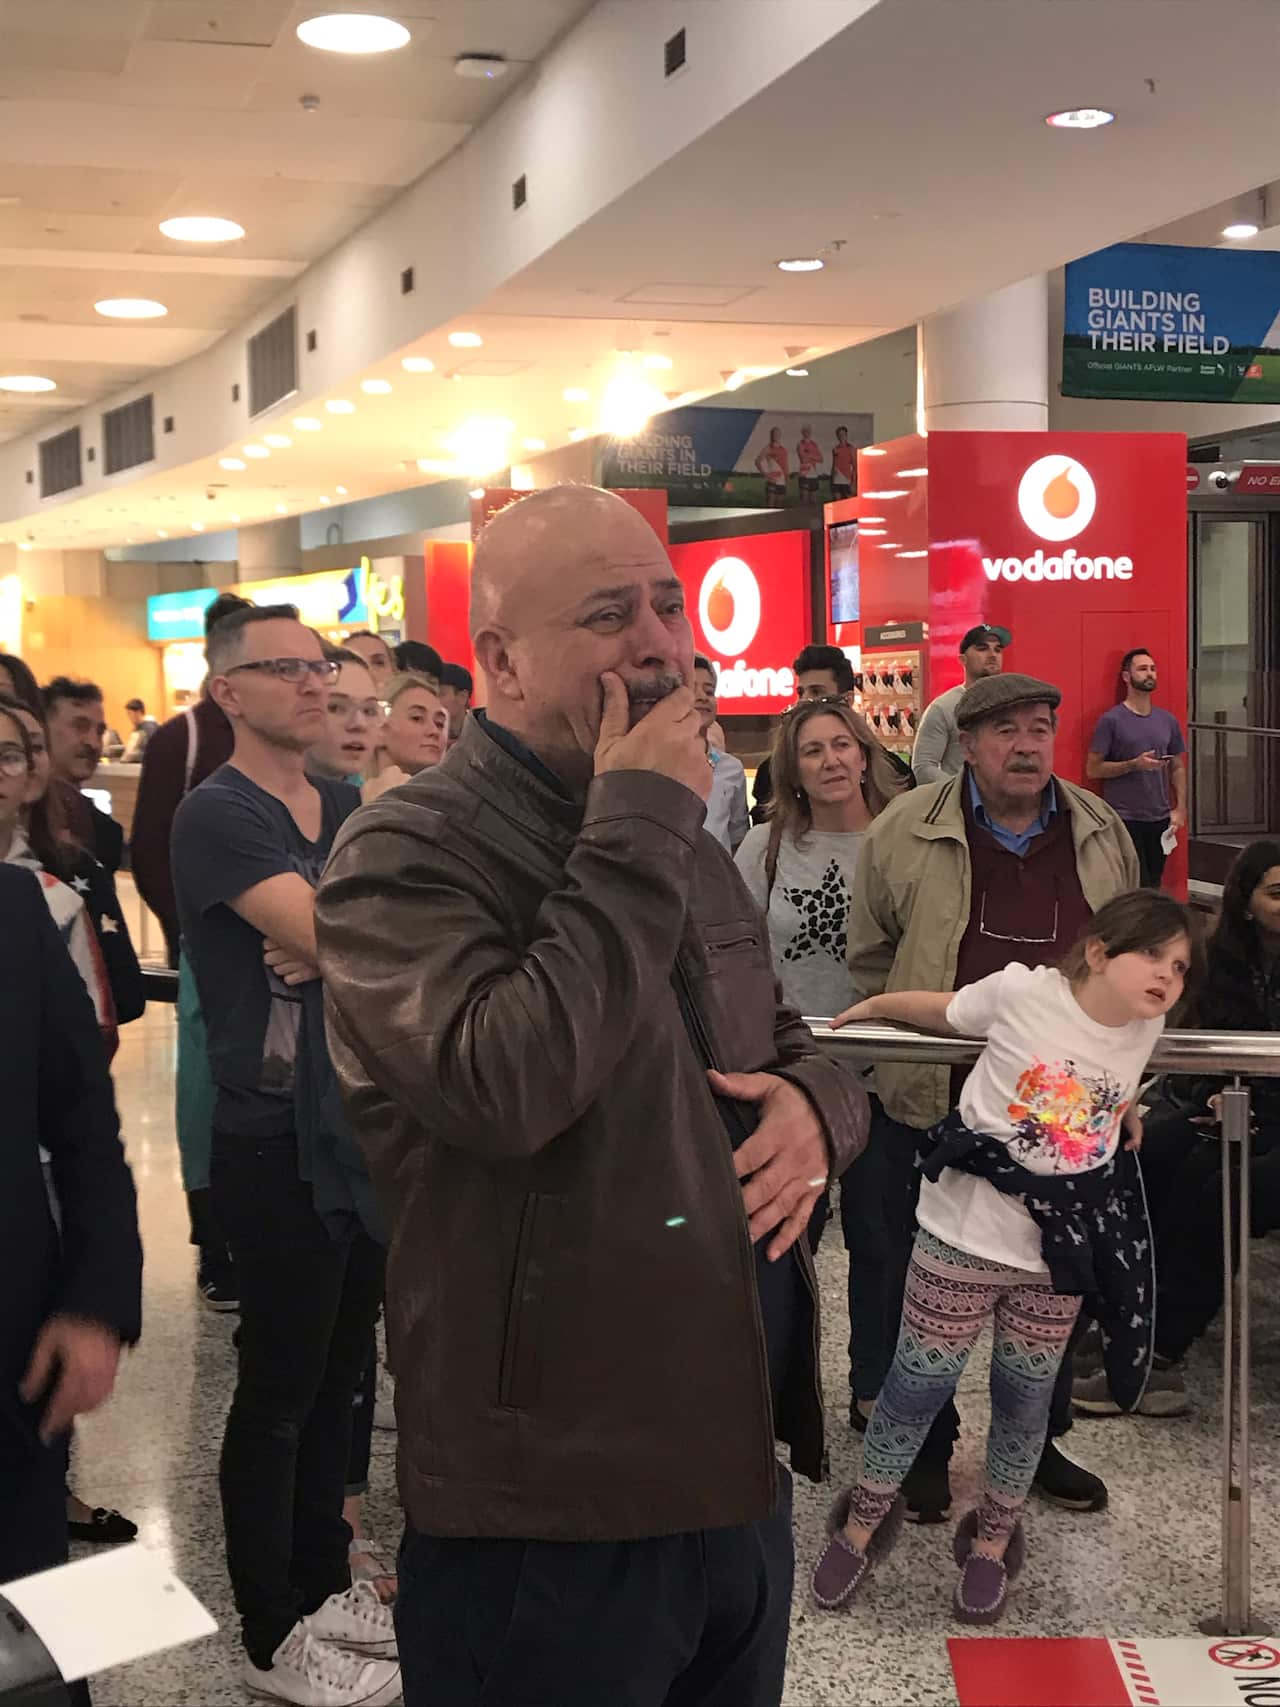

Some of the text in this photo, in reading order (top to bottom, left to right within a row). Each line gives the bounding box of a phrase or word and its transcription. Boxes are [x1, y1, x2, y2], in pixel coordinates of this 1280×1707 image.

[1088, 287, 1200, 312] BUILDING
[1088, 309, 1205, 333] GIANTS IN
[1087, 330, 1230, 355] THEIR FIELD
[680, 449, 696, 462] IN
[617, 460, 712, 476] THEIR FIELD
[1247, 475, 1268, 486] NO
[981, 548, 1133, 582] vodafone
